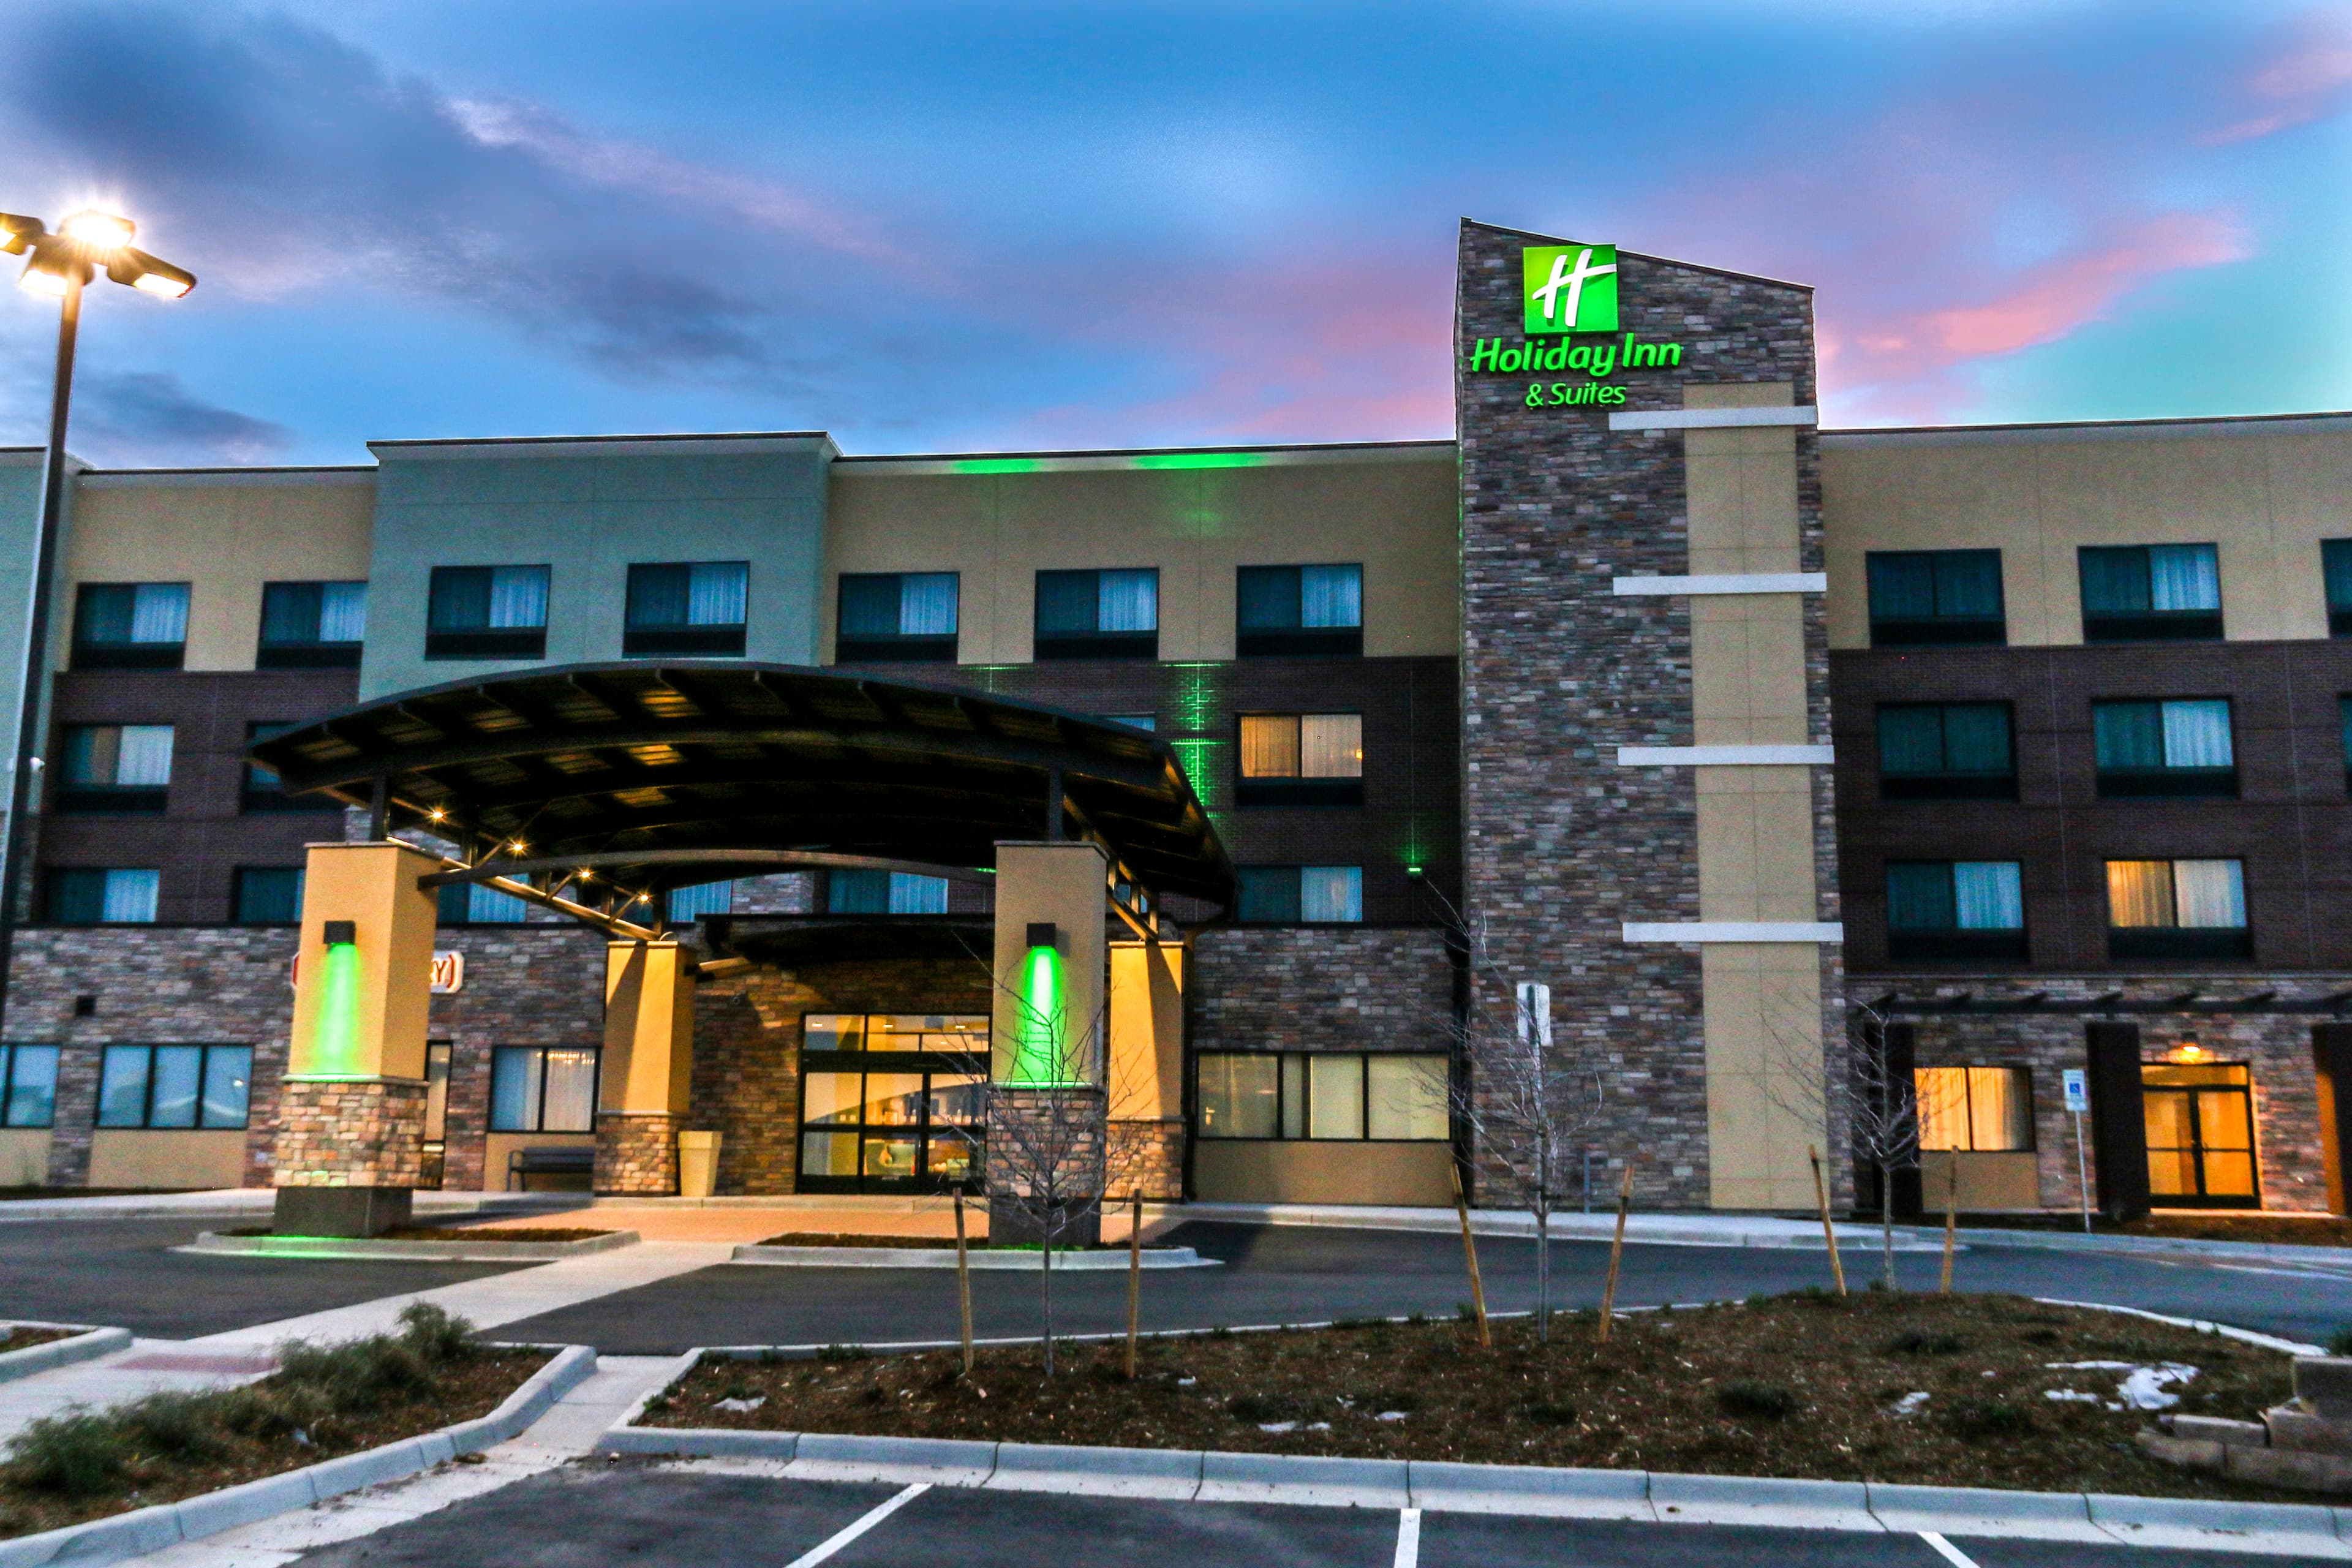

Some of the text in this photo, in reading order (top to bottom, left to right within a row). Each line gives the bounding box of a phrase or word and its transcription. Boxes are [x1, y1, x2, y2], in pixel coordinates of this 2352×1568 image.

[1470, 333, 1683, 377] Holiday Inn
[1525, 382, 1627, 407] & Suites
